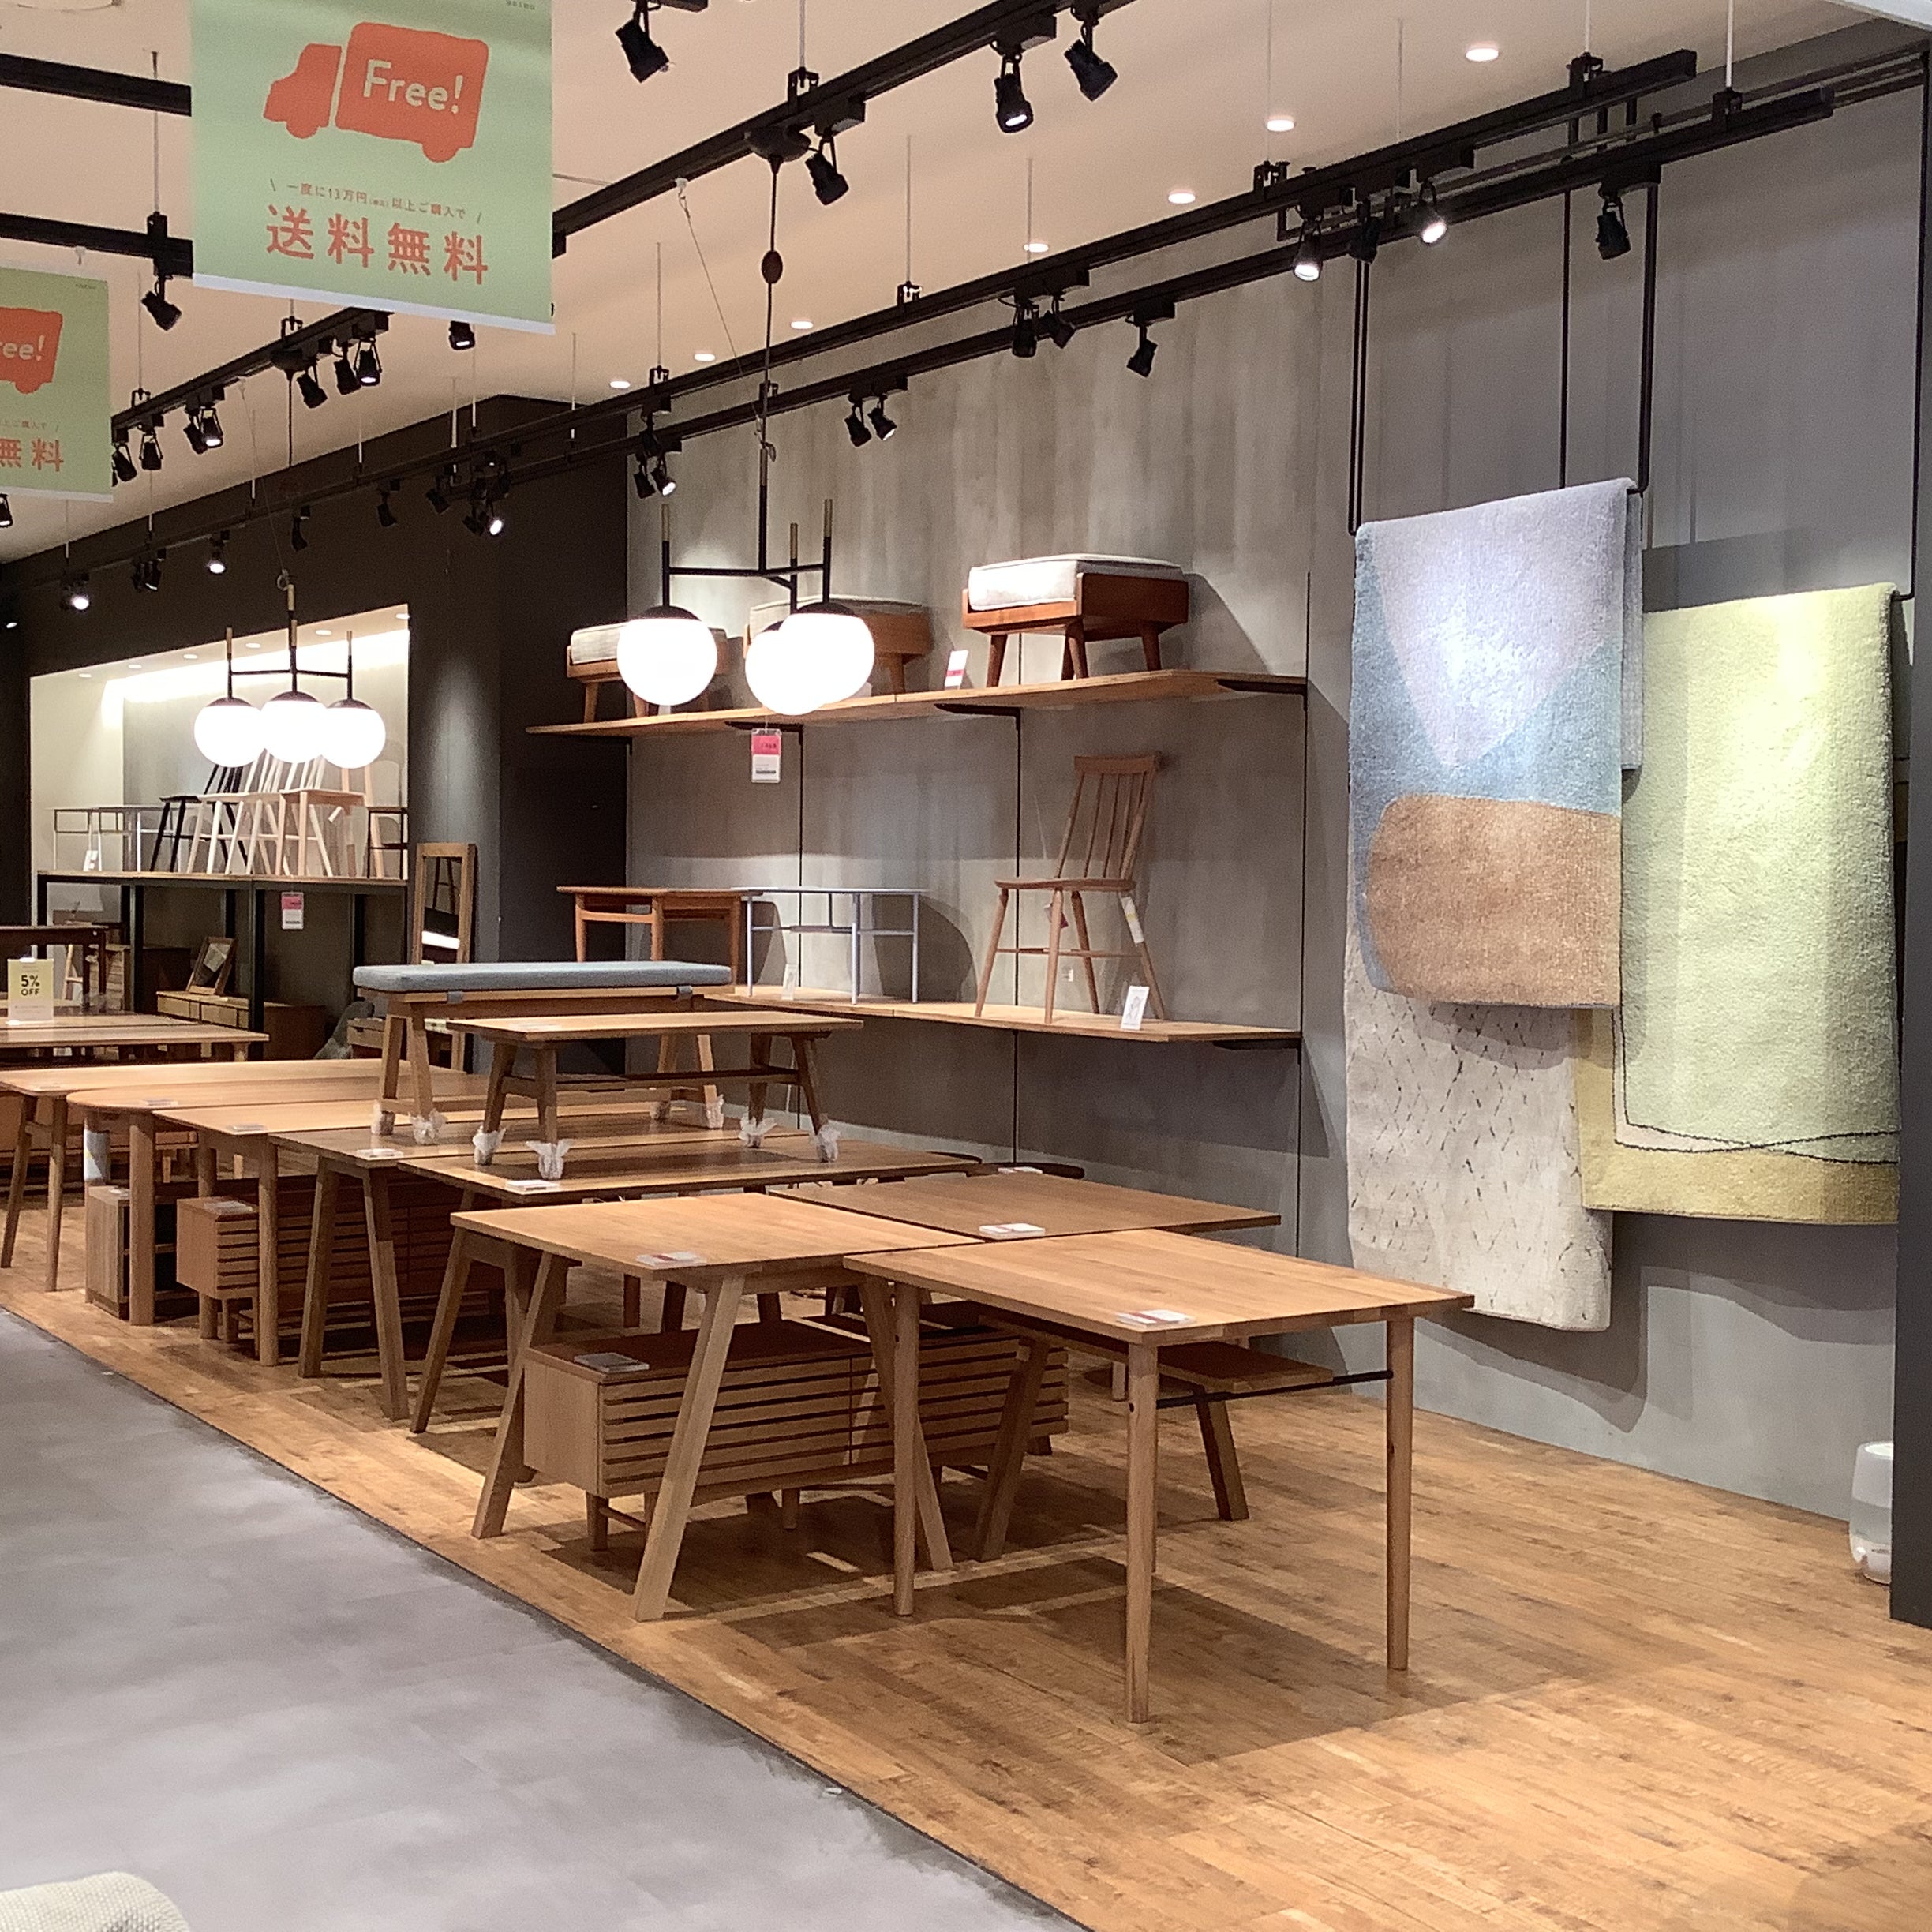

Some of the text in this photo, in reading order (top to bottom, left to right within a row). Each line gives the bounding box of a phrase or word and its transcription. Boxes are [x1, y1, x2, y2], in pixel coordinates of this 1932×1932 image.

[363, 59, 464, 114] Free!
[266, 204, 489, 285] 送料無料
[0, 334, 45, 361] ee!
[21, 975, 40, 987] 5%
[21, 988, 40, 997] OFF
